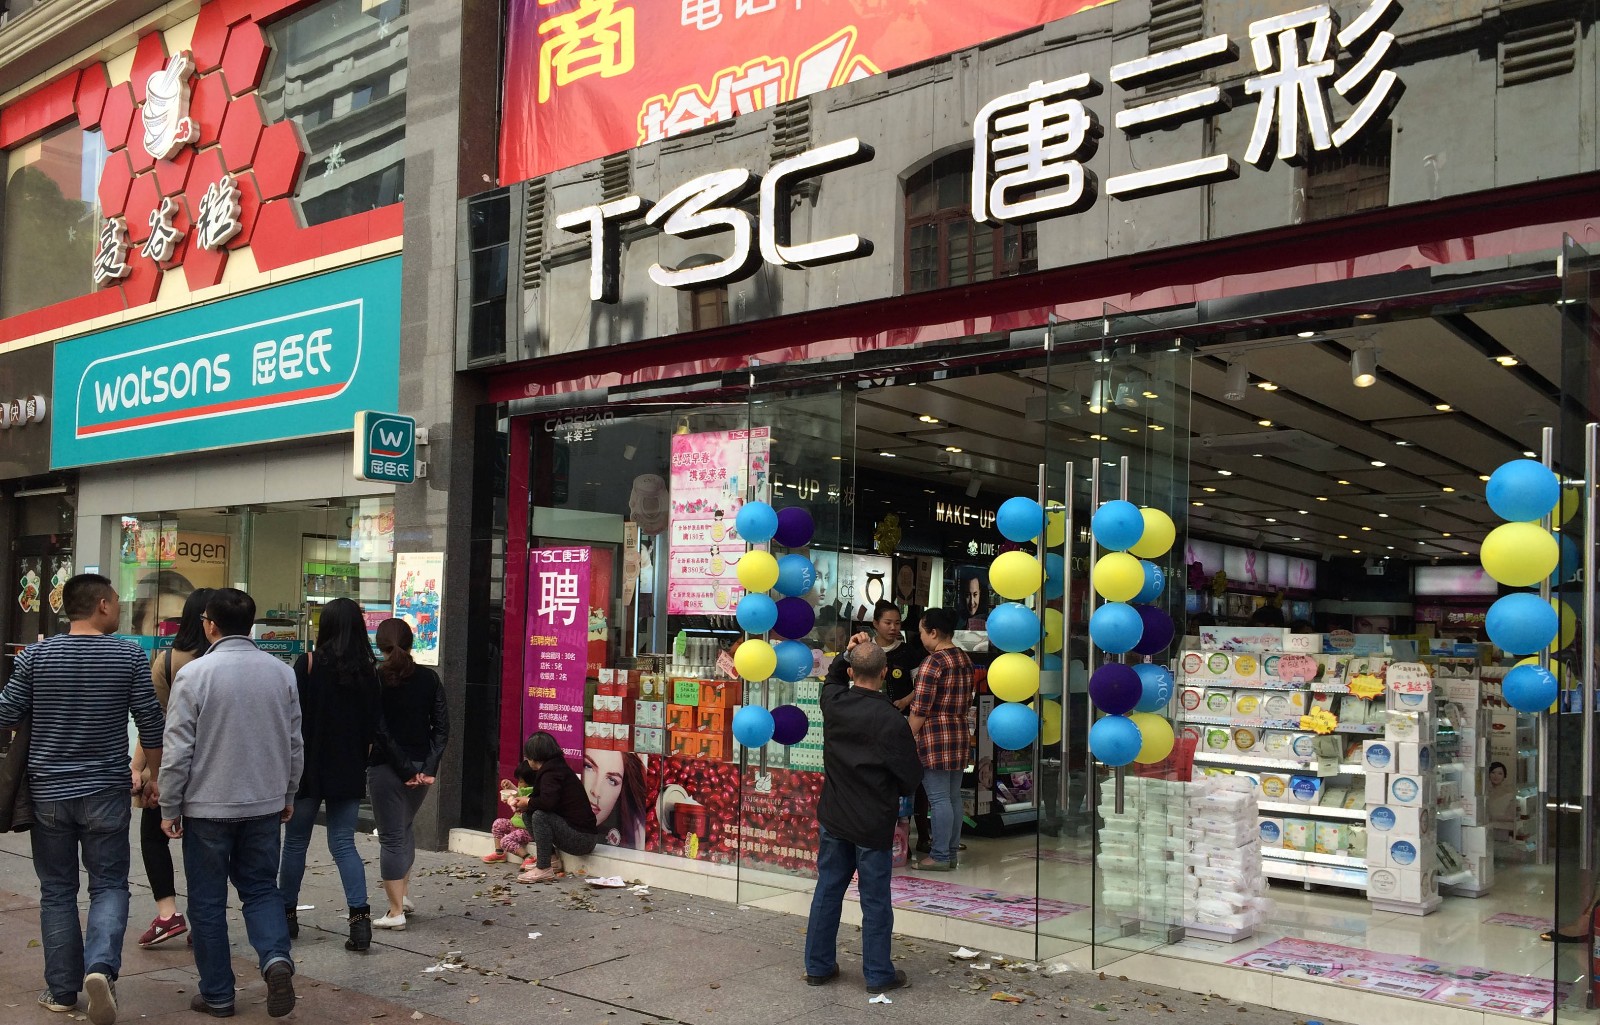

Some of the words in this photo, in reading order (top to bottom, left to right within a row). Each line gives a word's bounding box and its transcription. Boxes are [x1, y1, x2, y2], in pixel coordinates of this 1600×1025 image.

[556, 137, 872, 301] TSC
[972, 0, 1402, 224] 唐三彩
[94, 175, 243, 284] 麦谷粒
[94, 353, 231, 414] watsons
[252, 327, 333, 386] 屈臣氏
[379, 428, 403, 447] W
[371, 460, 409, 477] 屈臣氏
[936, 501, 996, 529] MAKE-UP
[537, 568, 580, 626] 聘
